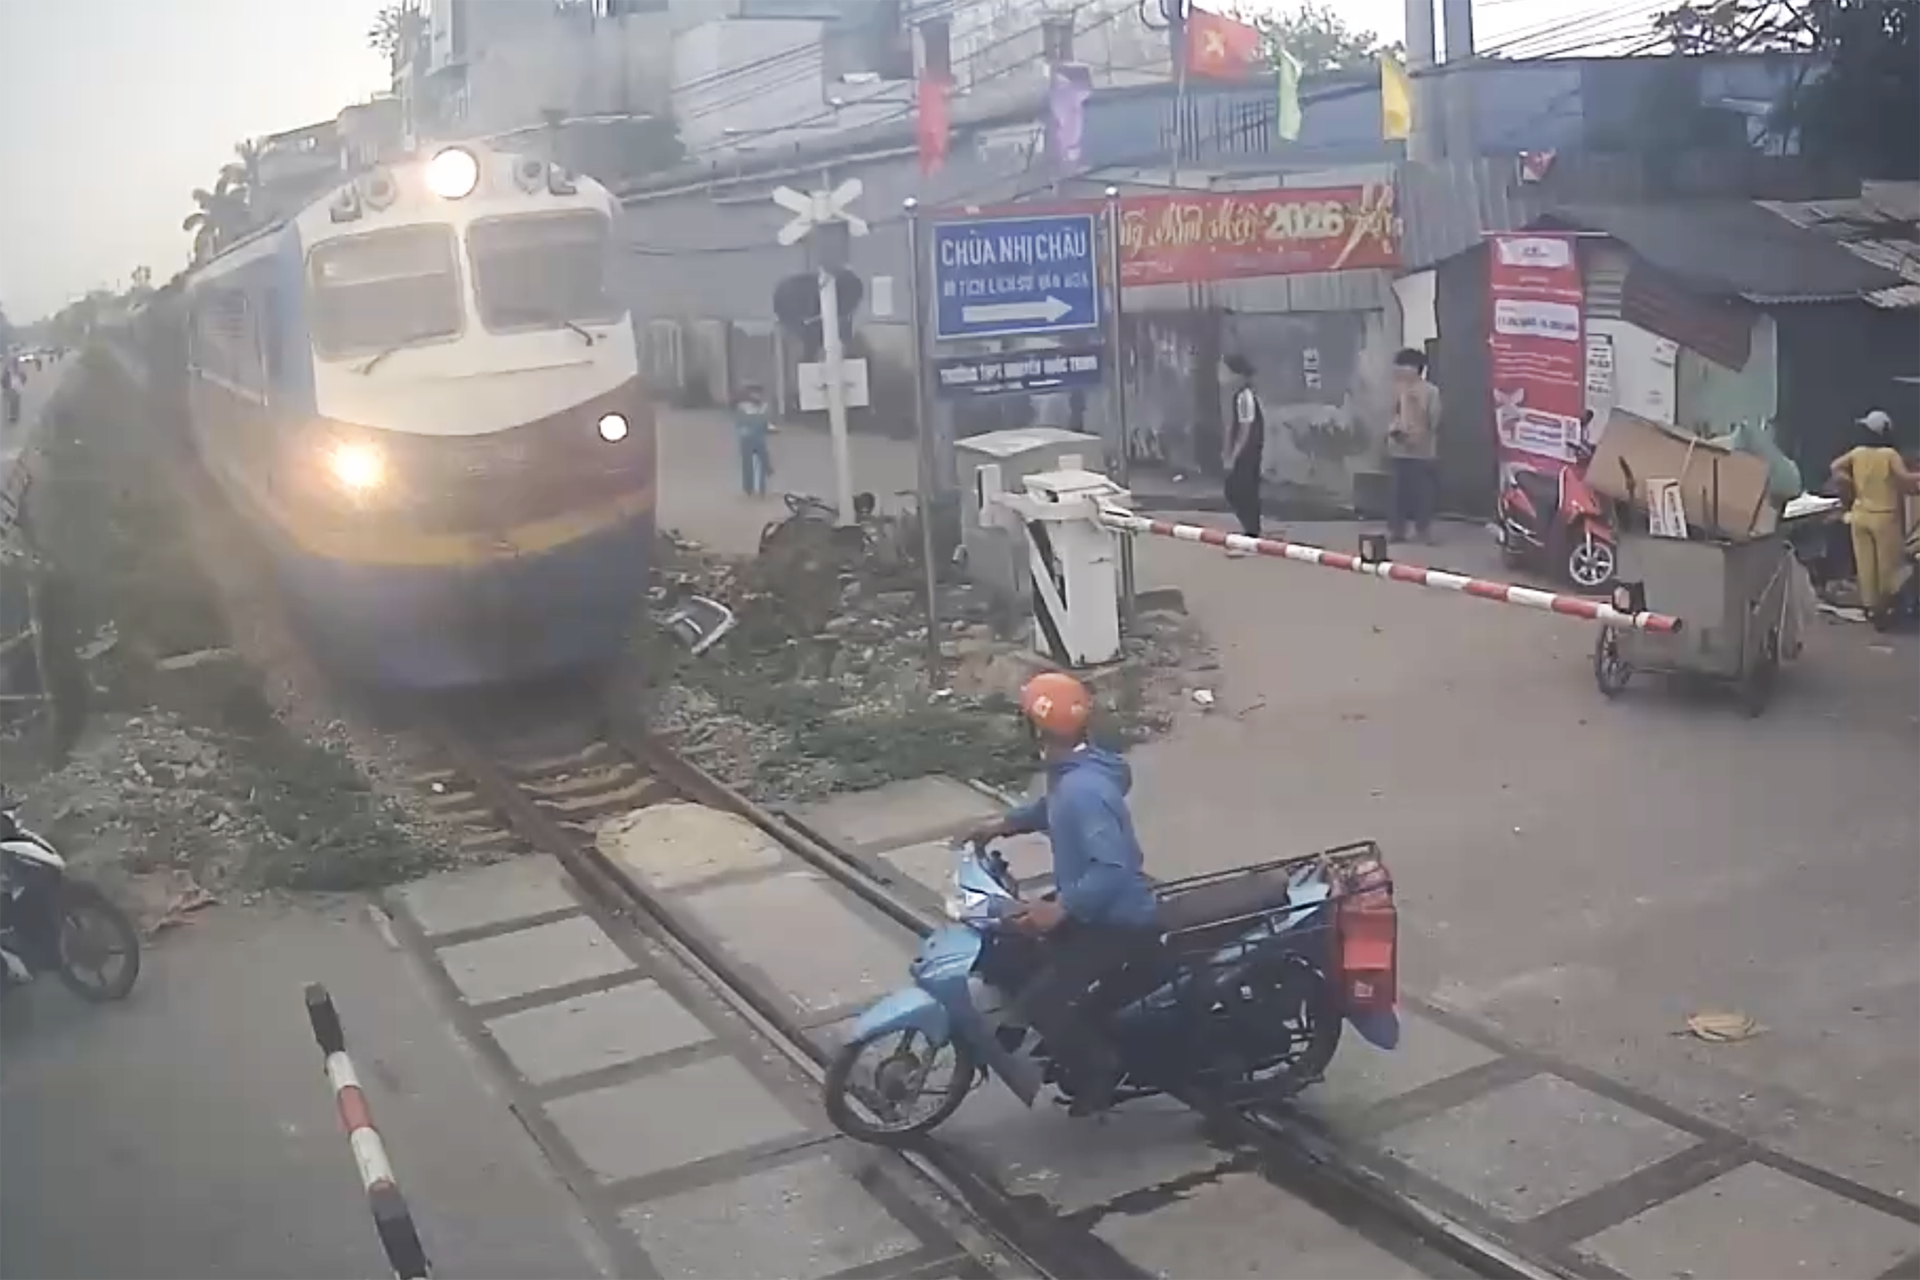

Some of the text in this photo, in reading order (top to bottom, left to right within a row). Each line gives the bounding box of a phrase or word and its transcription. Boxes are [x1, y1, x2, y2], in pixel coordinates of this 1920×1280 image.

[1264, 201, 1345, 240] 2026
[1000, 235, 1032, 266] NHỊ
[1035, 226, 1086, 262] CHÂU
